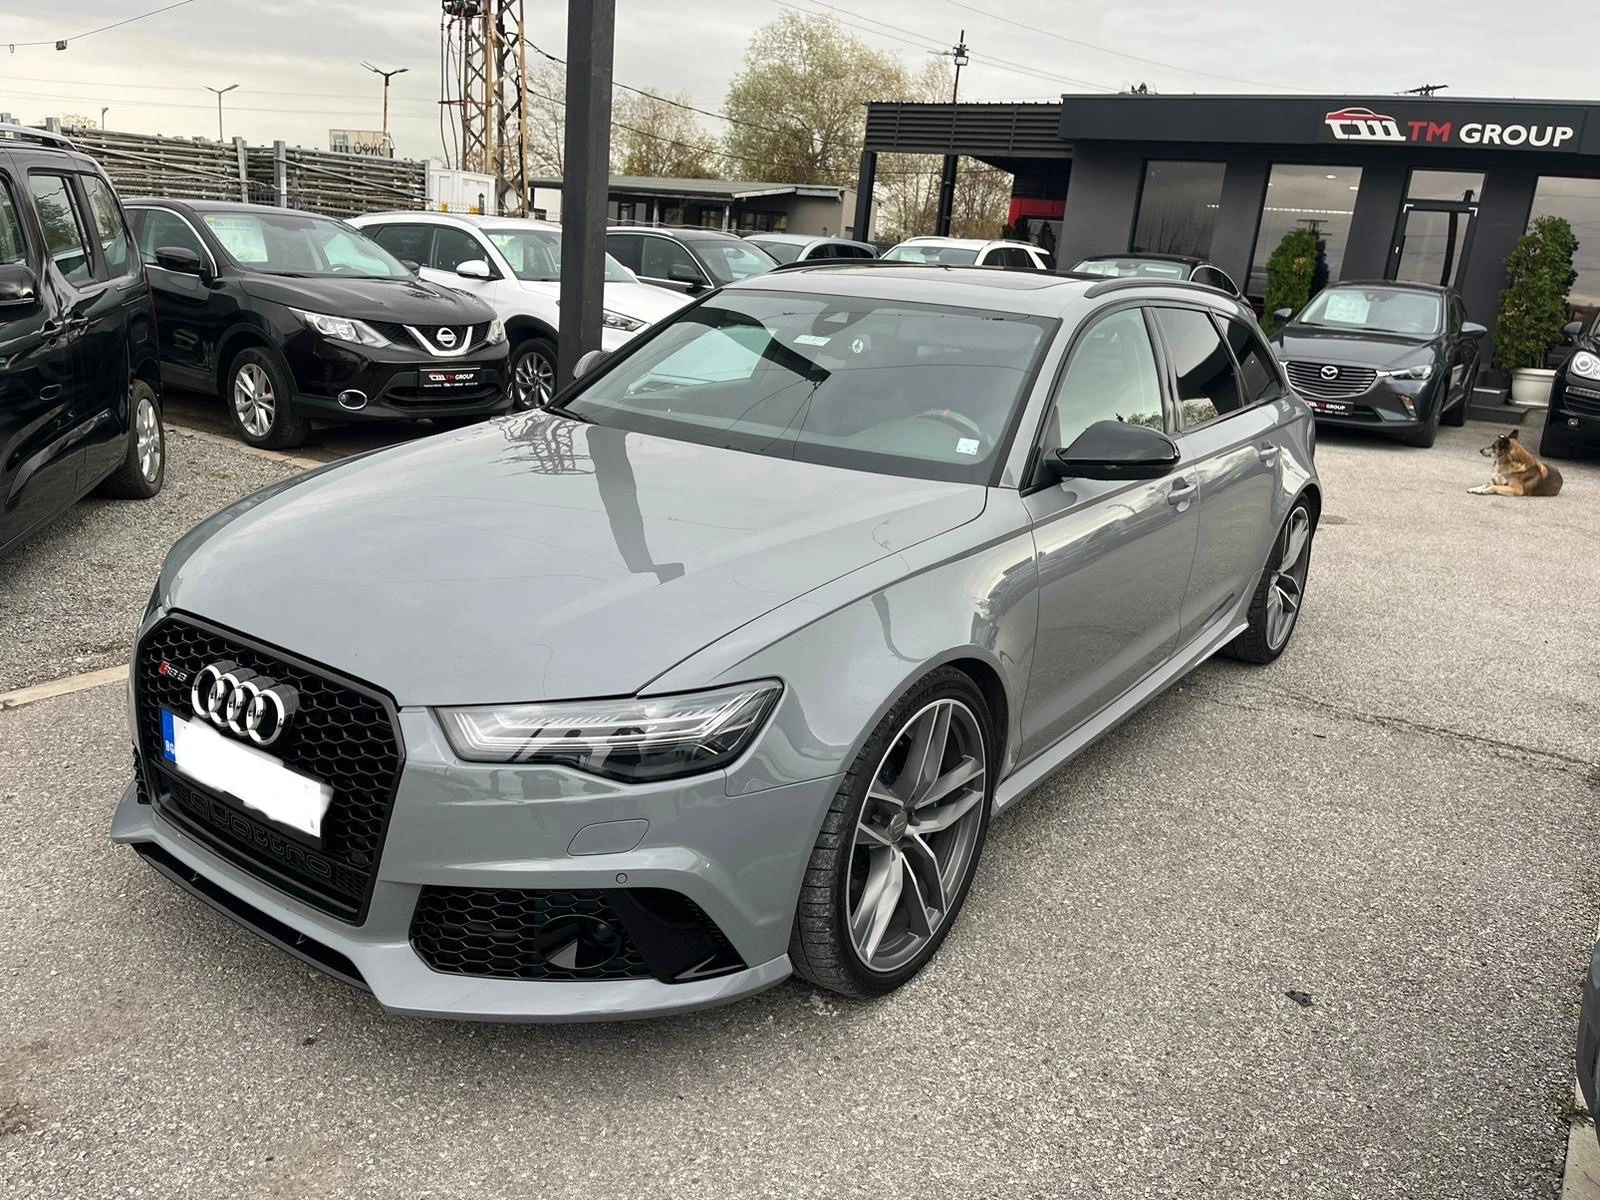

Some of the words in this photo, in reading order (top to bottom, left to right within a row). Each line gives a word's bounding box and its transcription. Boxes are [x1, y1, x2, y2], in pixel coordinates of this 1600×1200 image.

[1407, 120, 1453, 142] TM
[1459, 123, 1574, 147] GROUP
[190, 792, 332, 878] quattro
